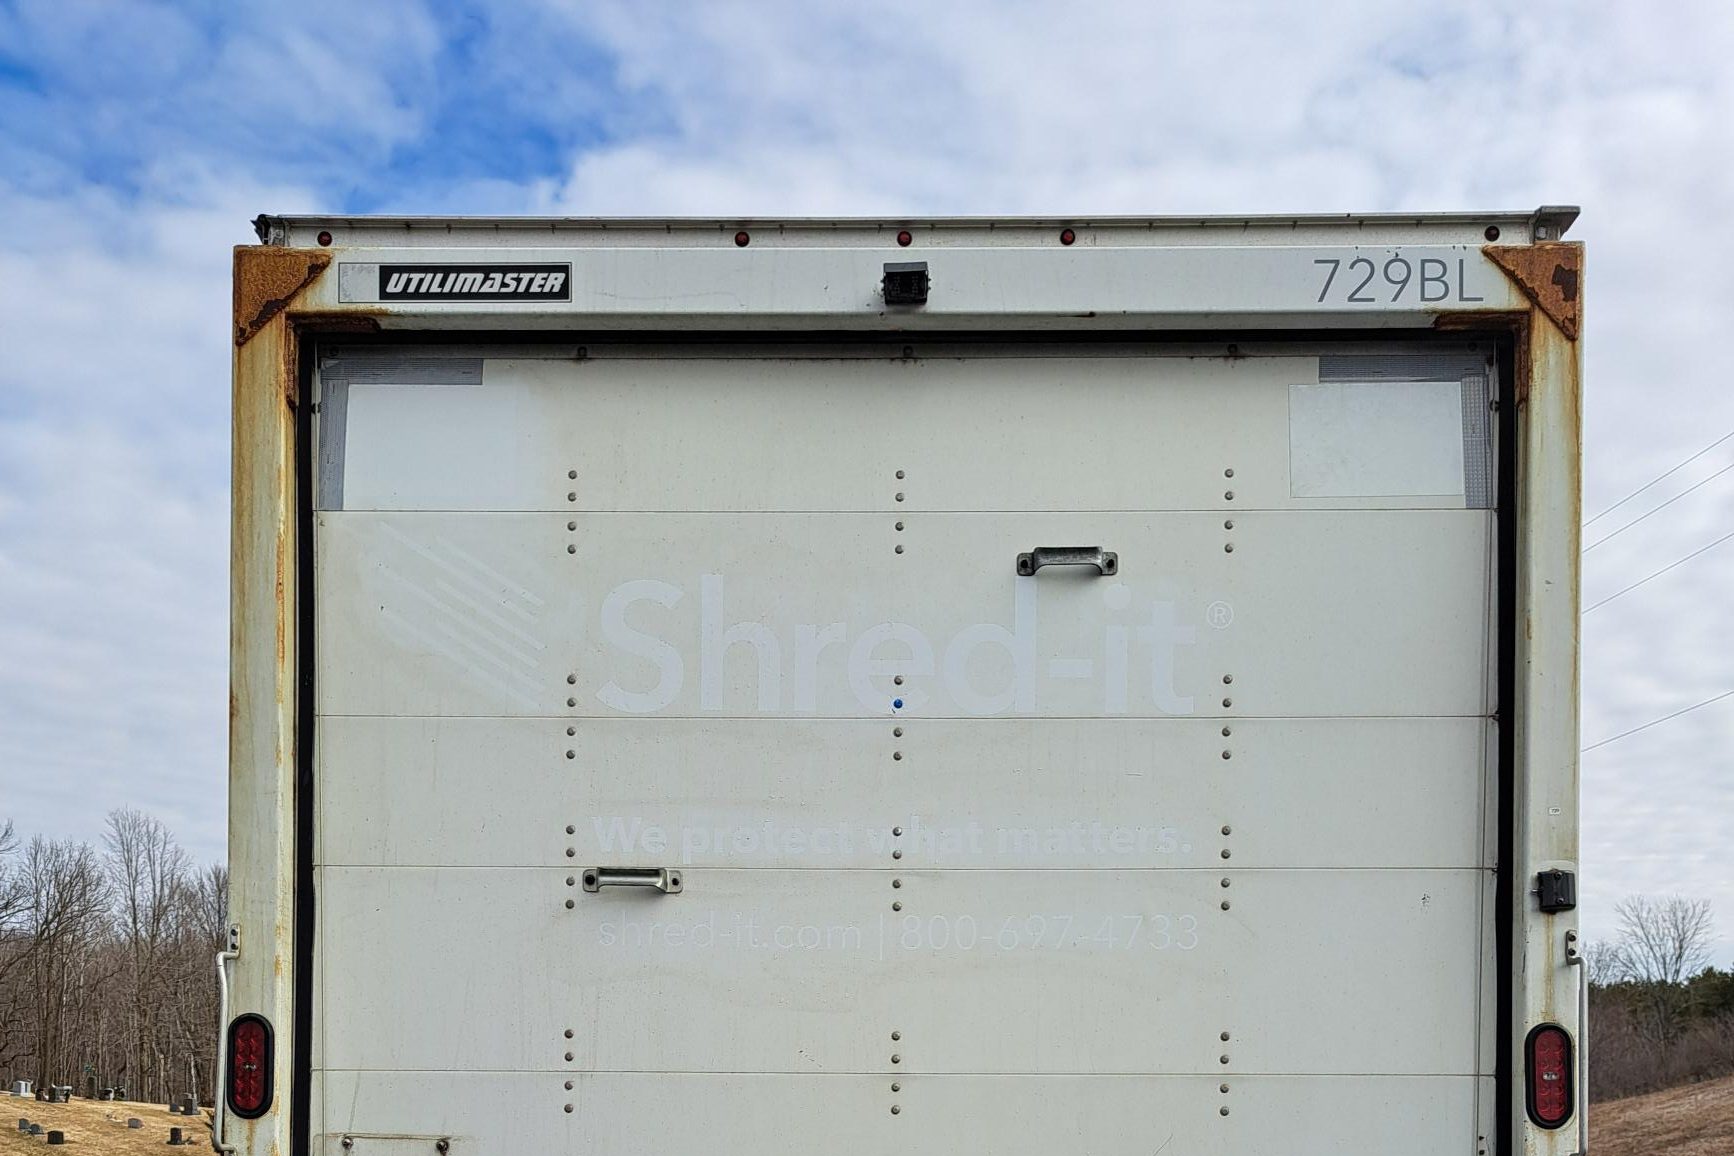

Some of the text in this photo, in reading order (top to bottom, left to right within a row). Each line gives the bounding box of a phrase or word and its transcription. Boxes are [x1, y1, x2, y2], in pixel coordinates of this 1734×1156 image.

[385, 272, 566, 293] UTILIMASTER
[1313, 257, 1485, 303] 729BL
[592, 814, 1193, 865] We protect what matters.
[599, 910, 862, 950] shred-it.com
[901, 914, 1199, 951] 800-697-4733
